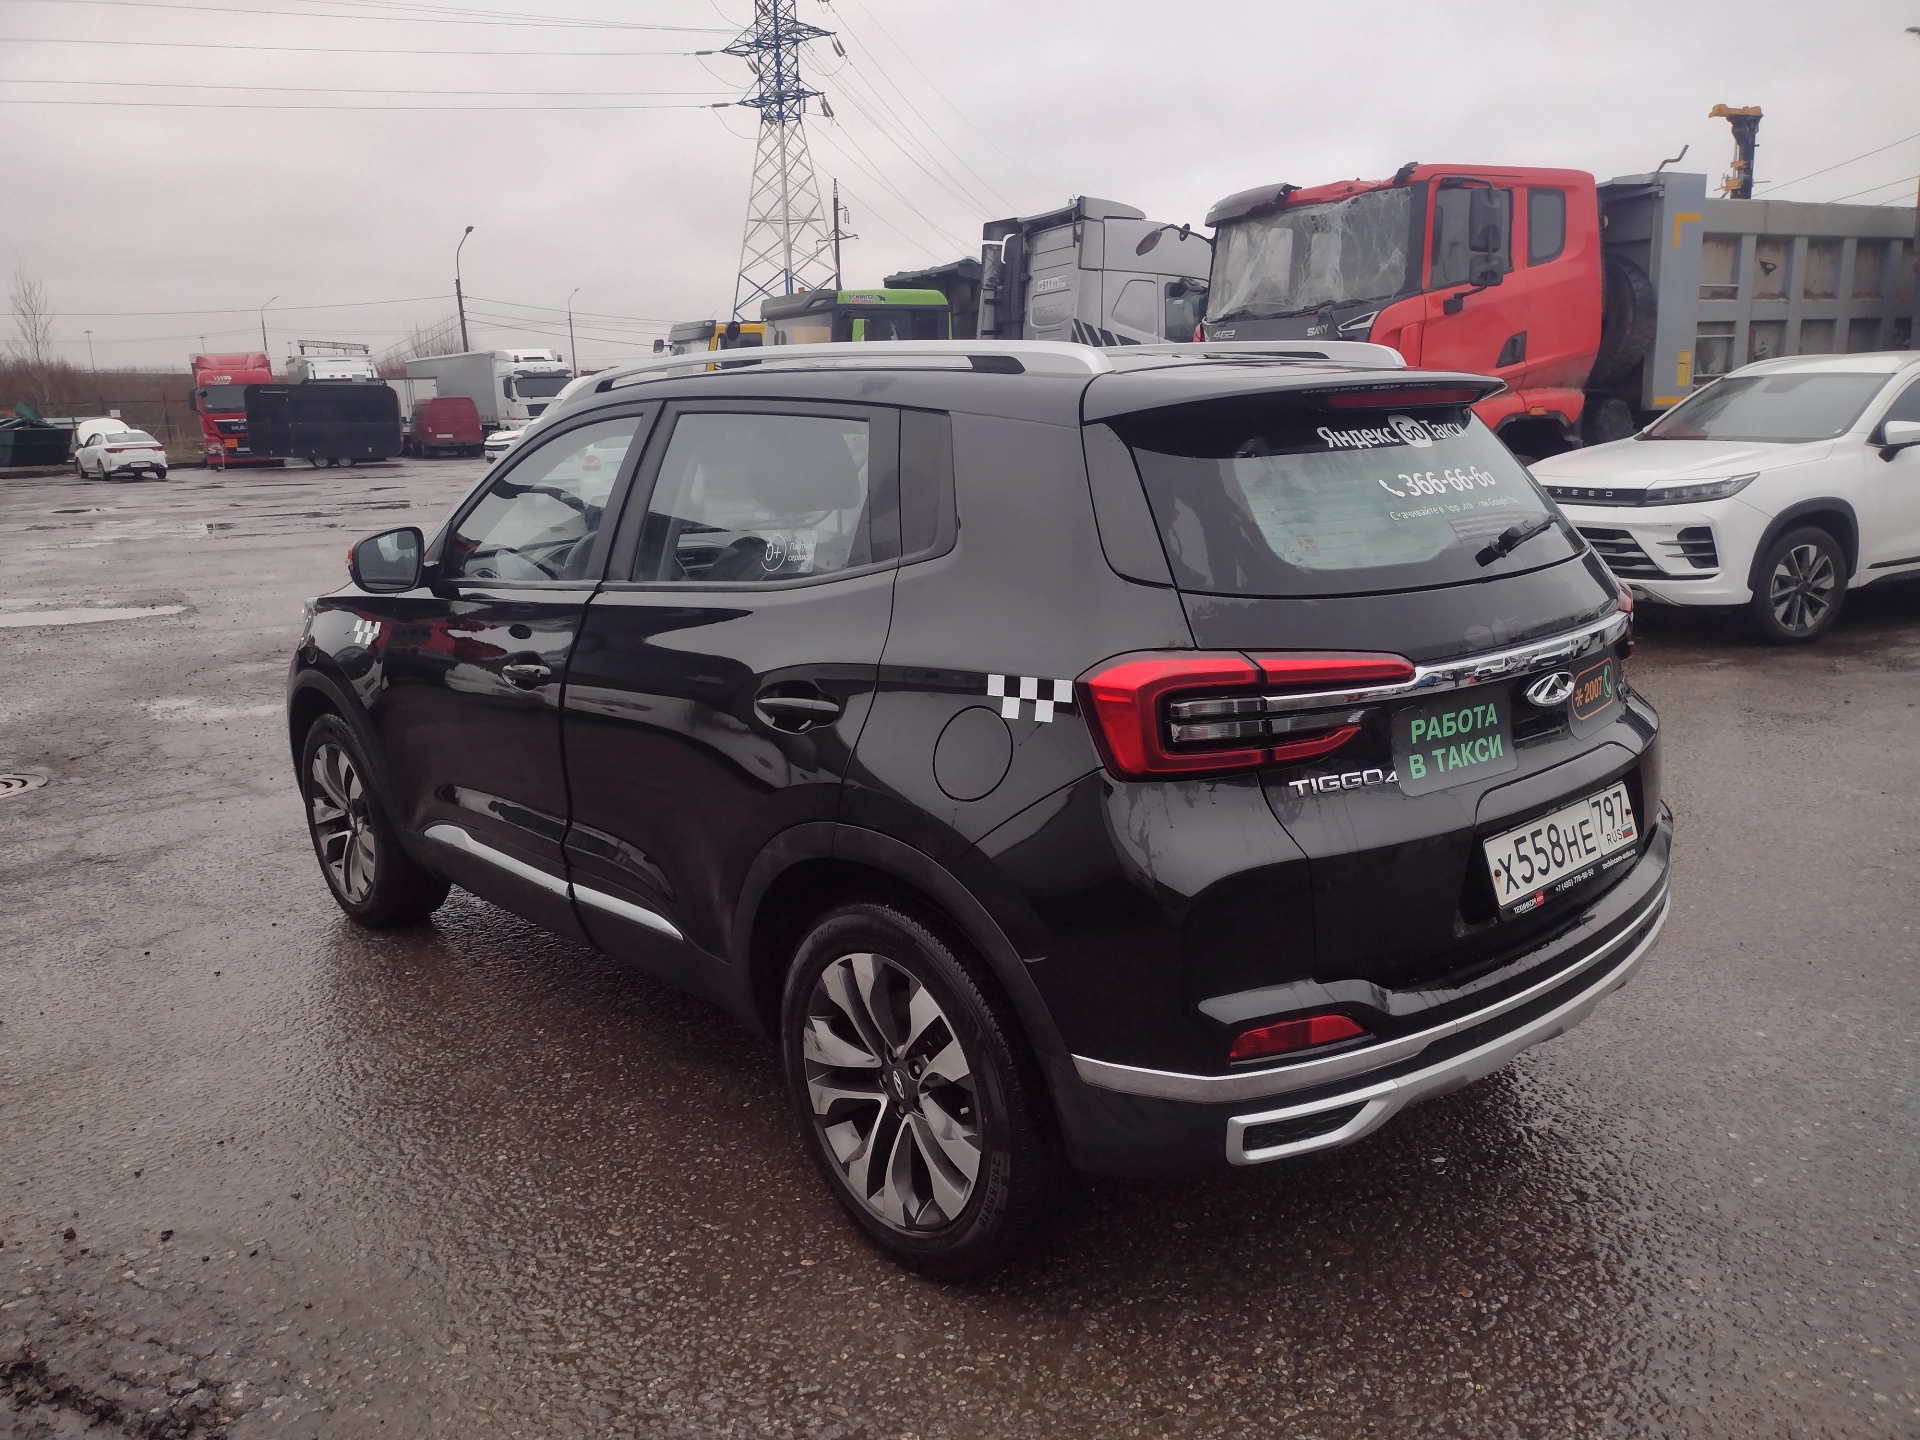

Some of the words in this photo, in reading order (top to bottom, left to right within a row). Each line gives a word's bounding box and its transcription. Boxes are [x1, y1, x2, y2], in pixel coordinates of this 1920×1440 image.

[1316, 426, 1400, 449] Яндекс
[1418, 419, 1469, 440] Такси
[1410, 703, 1498, 744] РАБОТА
[1408, 753, 1427, 780] В
[1431, 733, 1504, 773] ТАКСИ
[1590, 790, 1624, 835] 797
[1606, 828, 1623, 846] RUS
